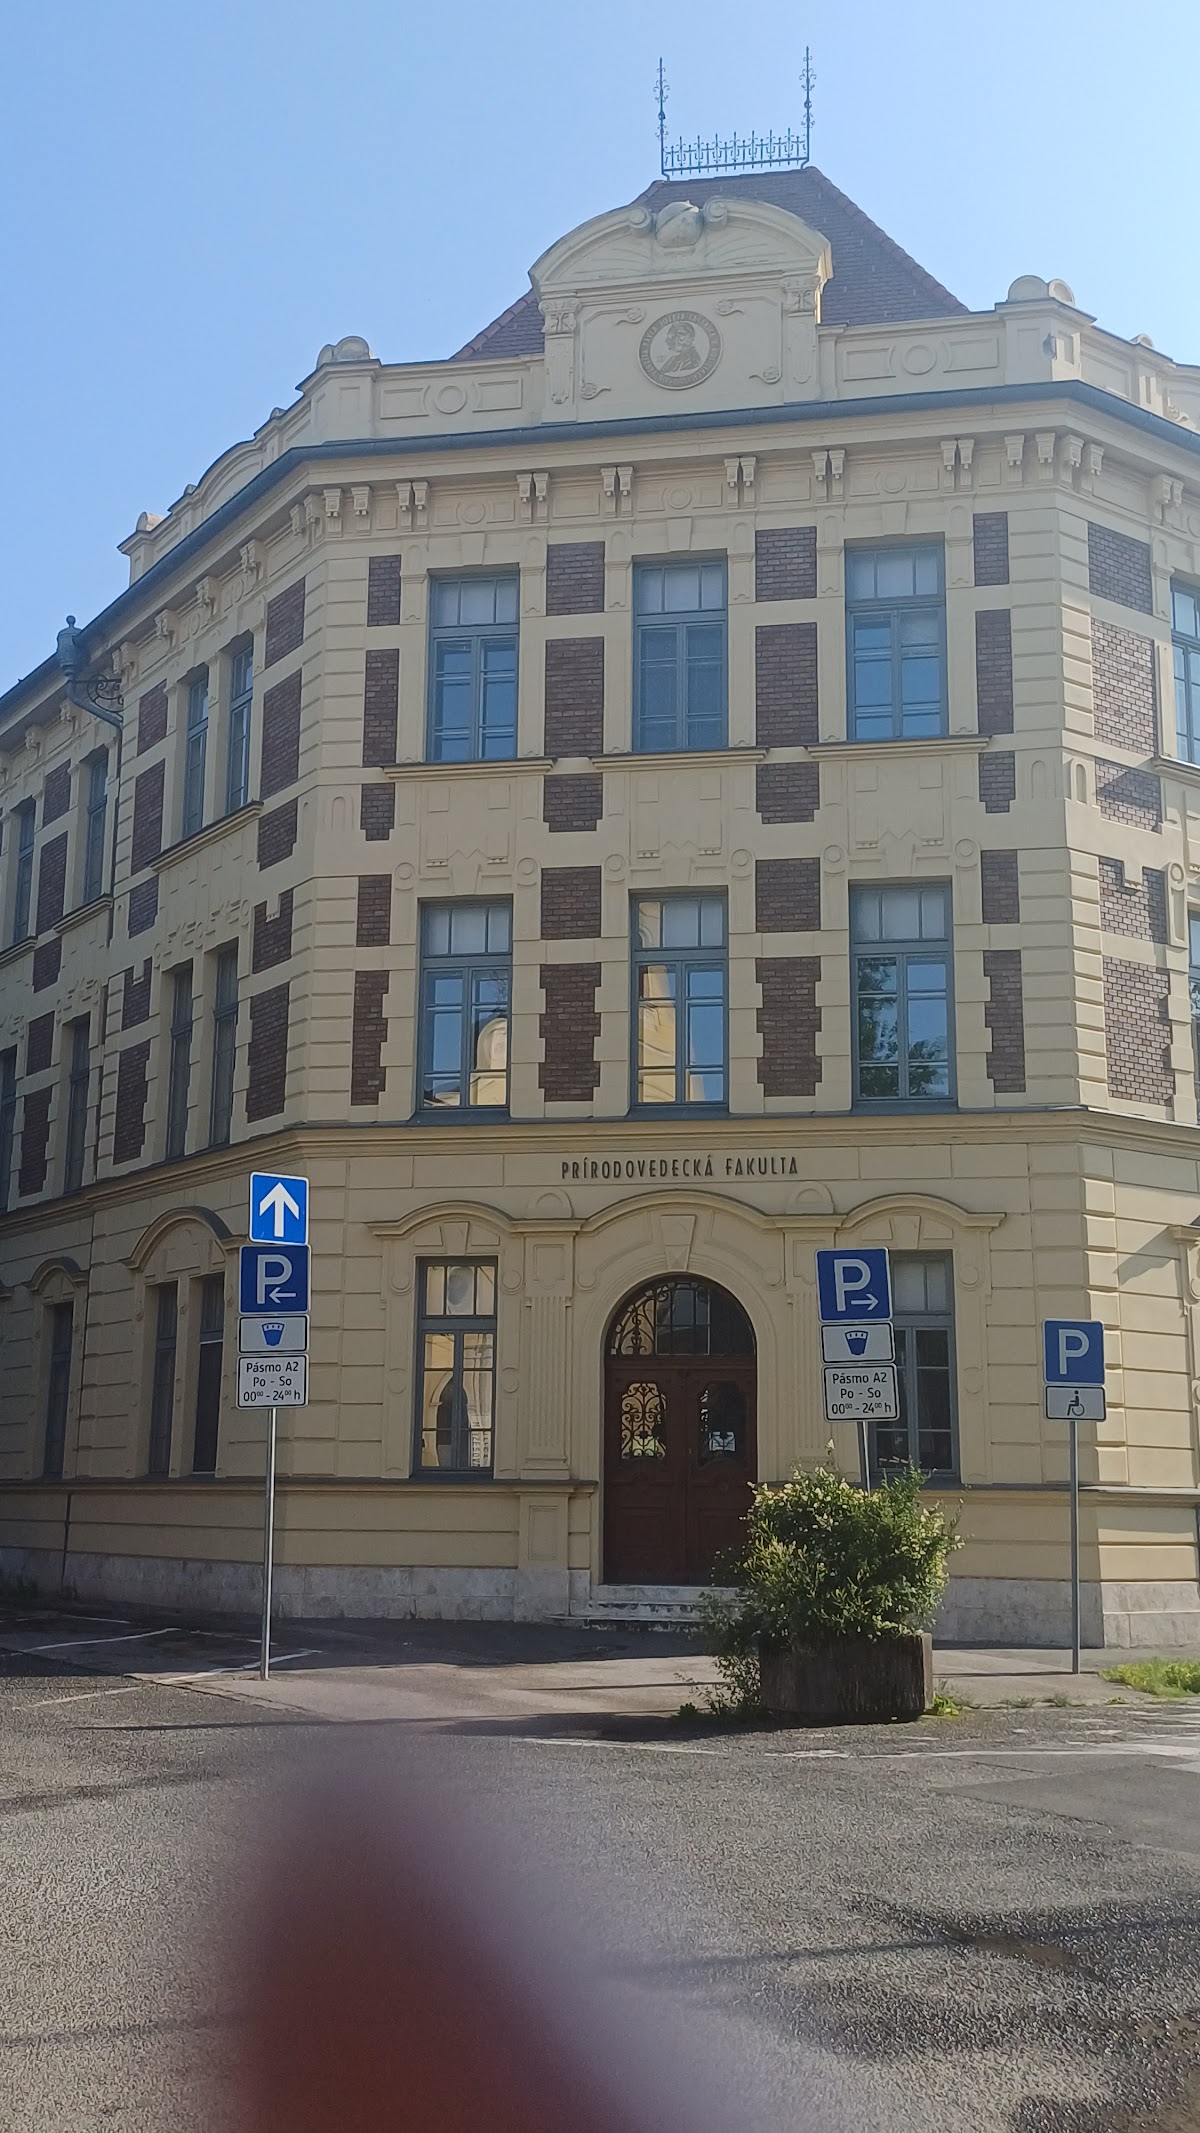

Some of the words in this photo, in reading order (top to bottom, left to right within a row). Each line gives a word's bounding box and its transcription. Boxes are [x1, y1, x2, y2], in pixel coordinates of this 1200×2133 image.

[561, 1155, 714, 1180] PRÍRODOVEDECKÁ
[725, 1156, 799, 1177] FAKULTA
[256, 1254, 293, 1305] P
[834, 1258, 871, 1312] P
[1058, 1328, 1090, 1375] P
[246, 1361, 282, 1373] Pásmo
[285, 1361, 299, 1372] A2
[253, 1376, 266, 1387] Po
[278, 1375, 292, 1387] So
[832, 1372, 869, 1385] Pásmo
[873, 1371, 888, 1383] A2
[293, 1389, 301, 1400] h
[840, 1388, 854, 1399] Po
[867, 1387, 882, 1399] So
[884, 1402, 892, 1413] h
